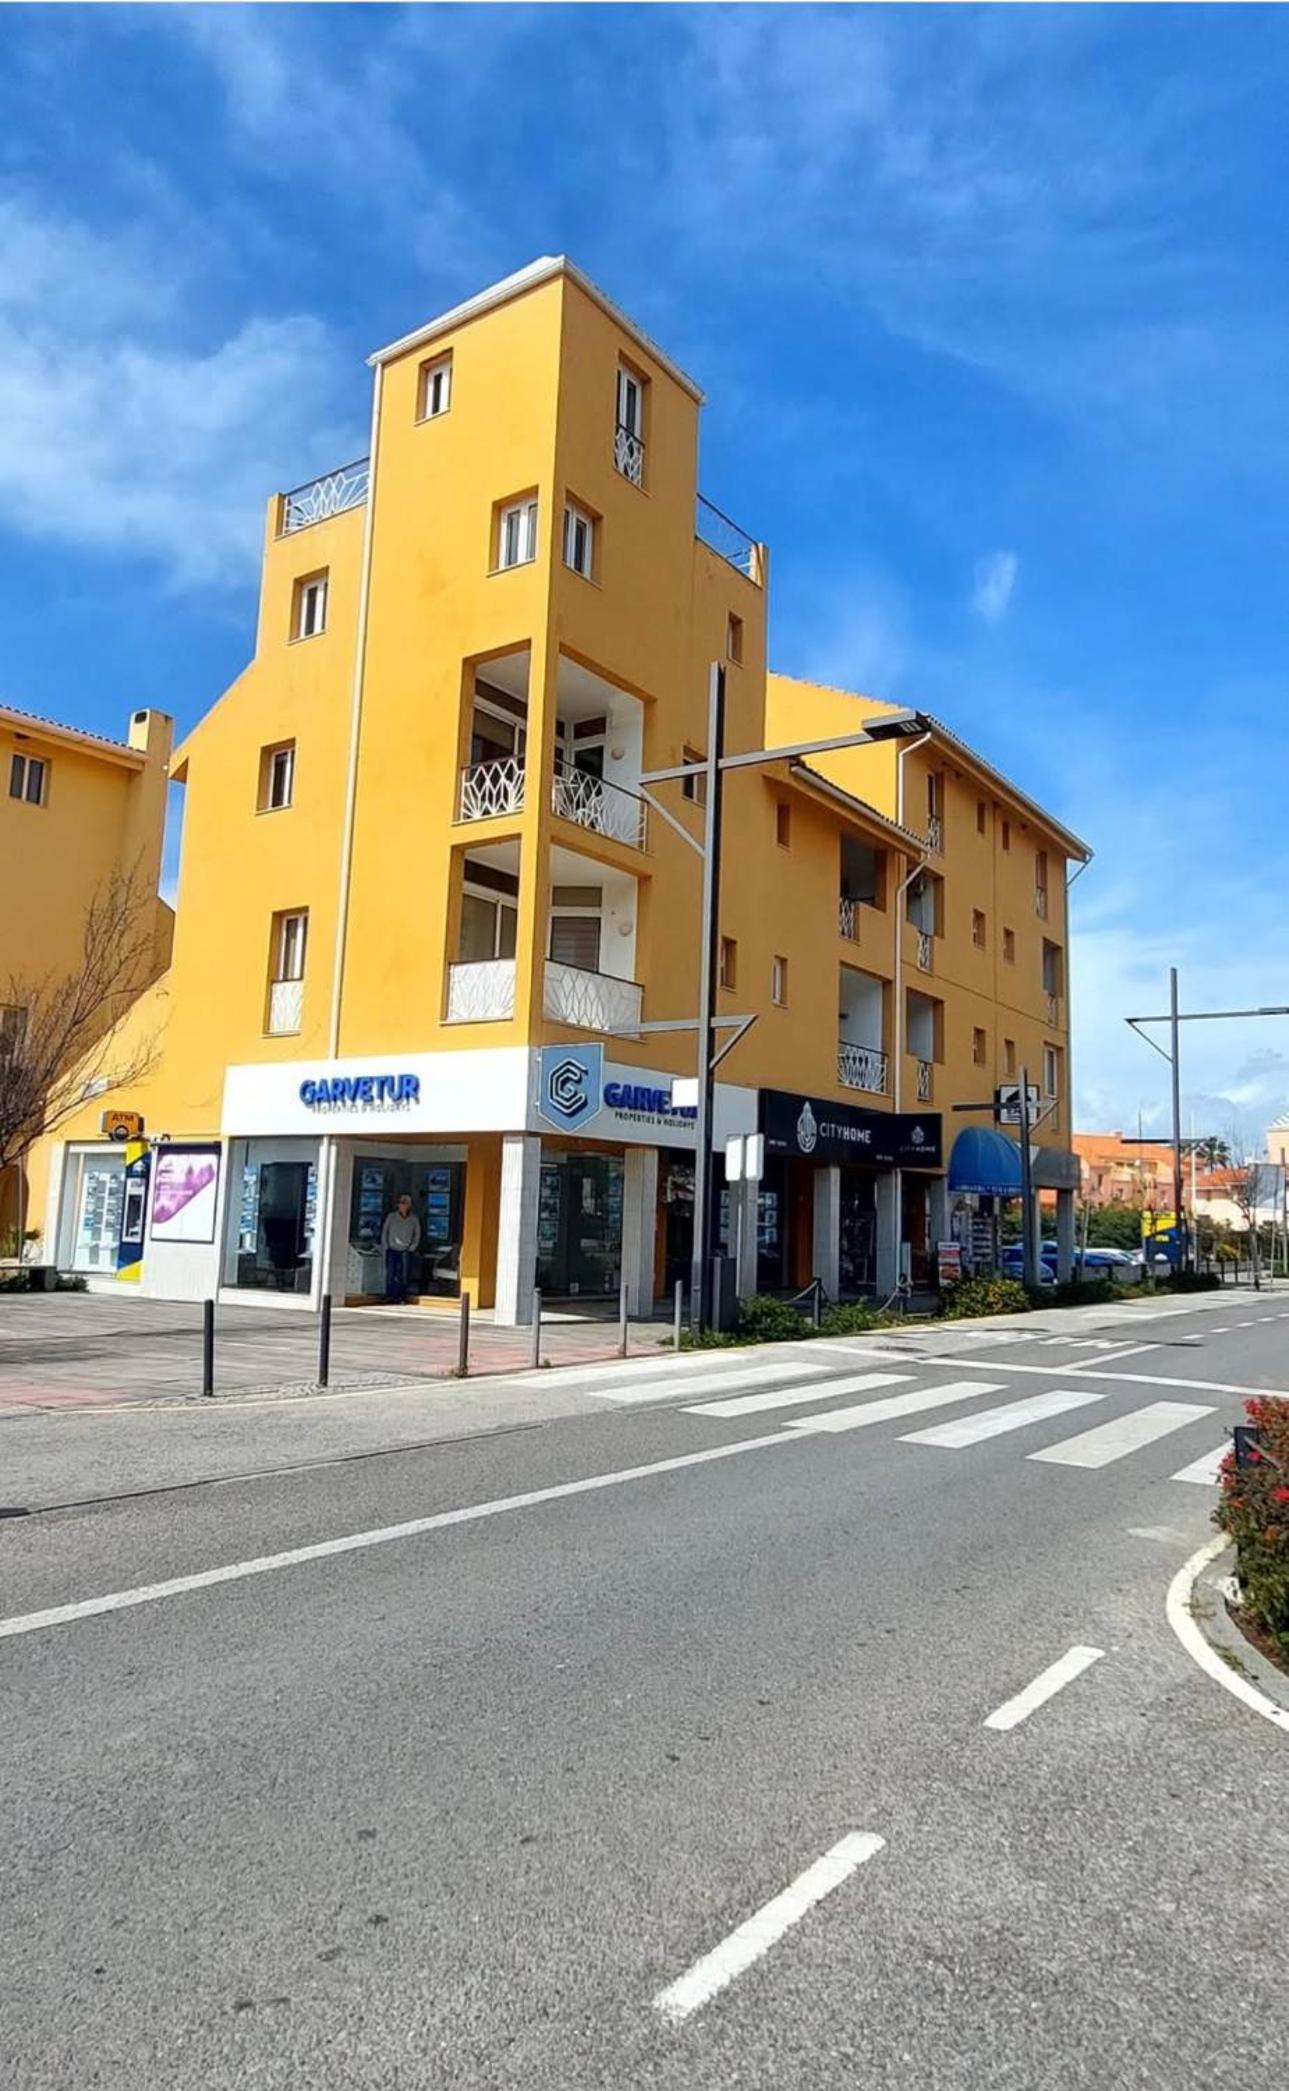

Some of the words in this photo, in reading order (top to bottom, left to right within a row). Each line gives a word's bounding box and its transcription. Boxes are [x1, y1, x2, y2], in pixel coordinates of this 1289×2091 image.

[300, 1074, 420, 1107] GARVETUR
[112, 1113, 134, 1121] ATM
[614, 1111, 656, 1125] PROPERTIES
[663, 1118, 695, 1130] HOLIDAYS
[819, 1121, 872, 1144] CITYHOME
